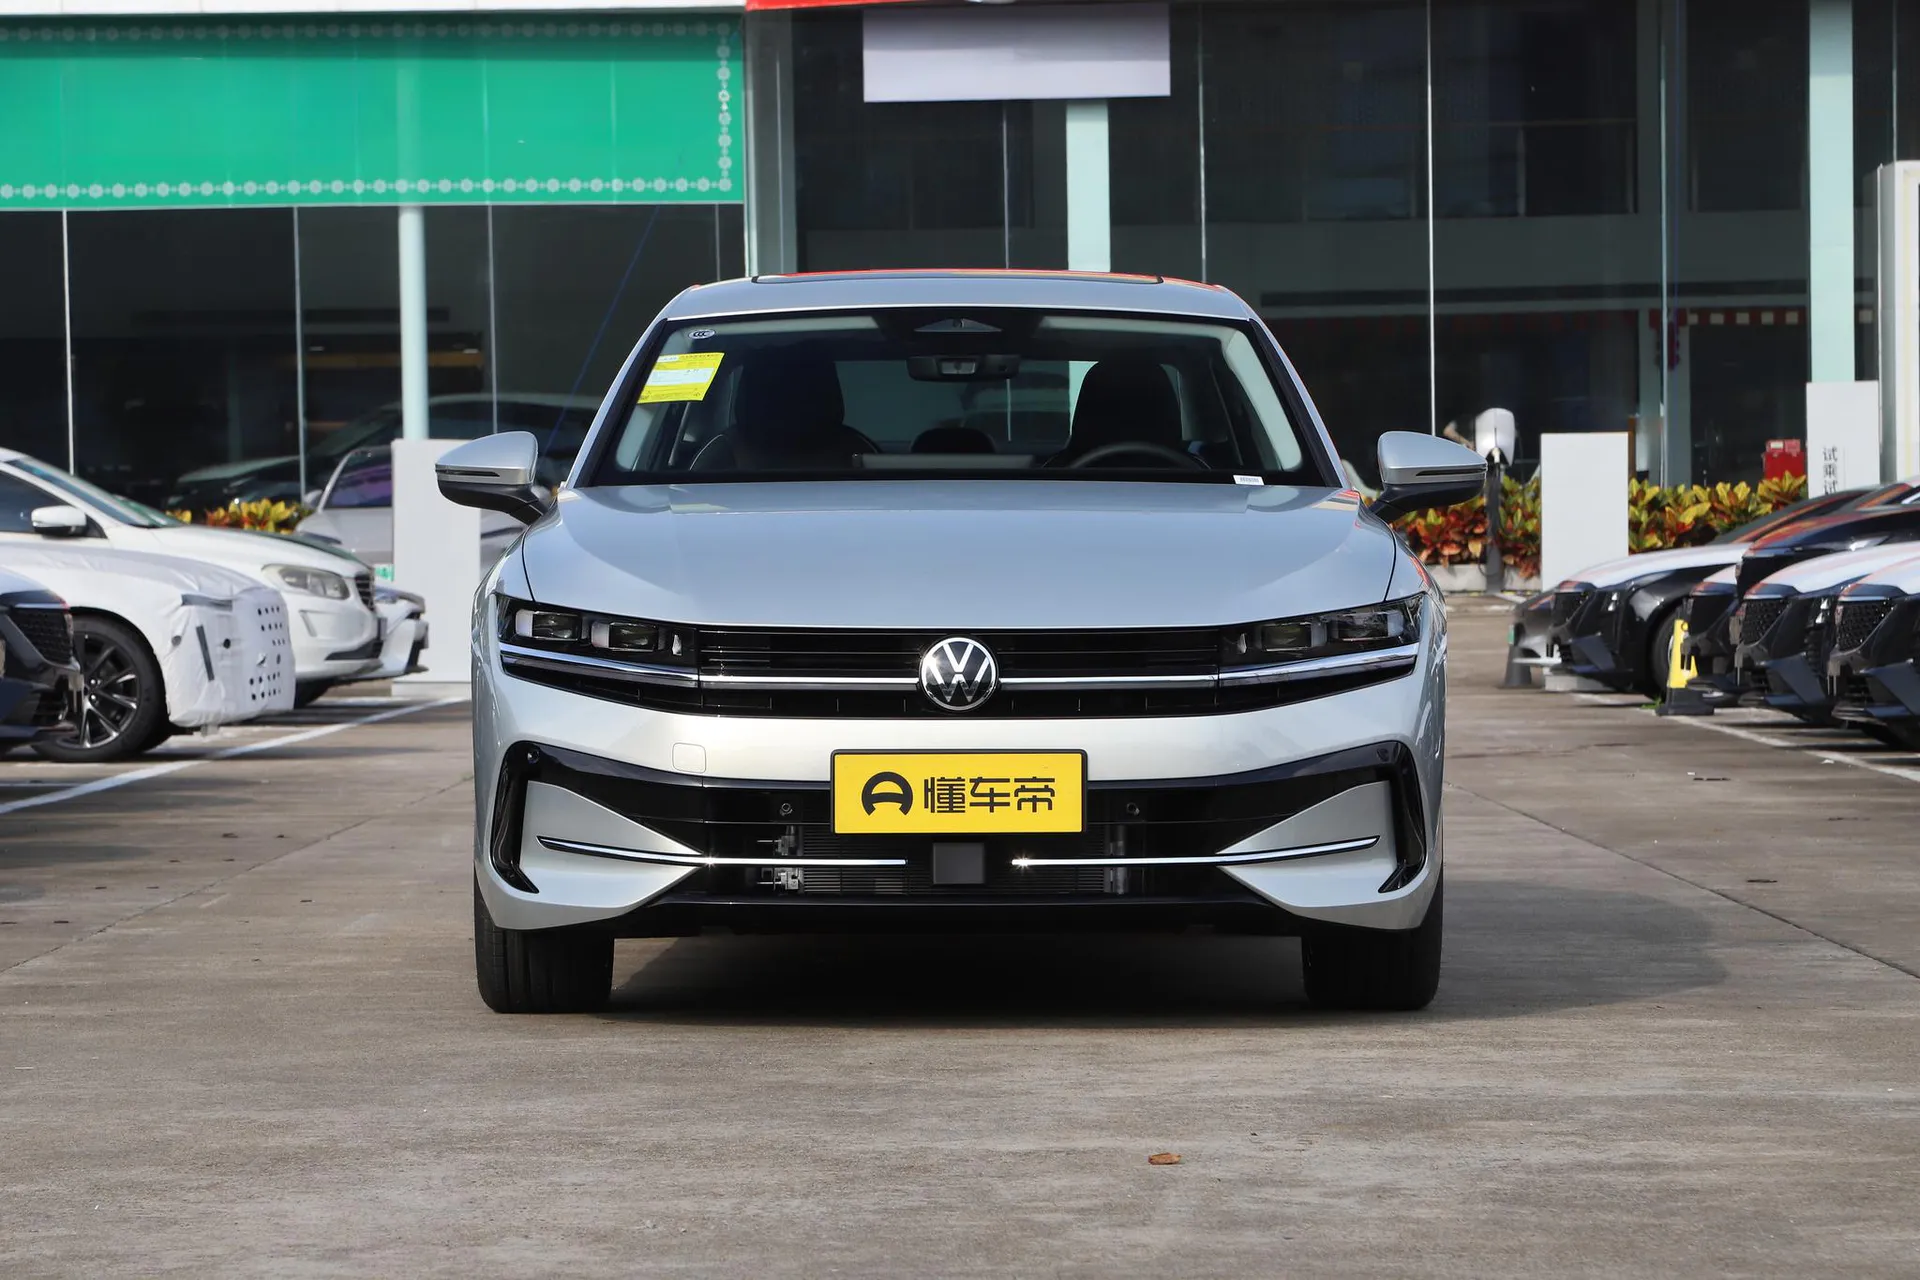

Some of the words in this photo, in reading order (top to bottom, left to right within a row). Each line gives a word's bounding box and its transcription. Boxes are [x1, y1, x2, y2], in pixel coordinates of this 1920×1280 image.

[926, 640, 992, 706] VW
[923, 776, 1056, 813] 懂车帝
